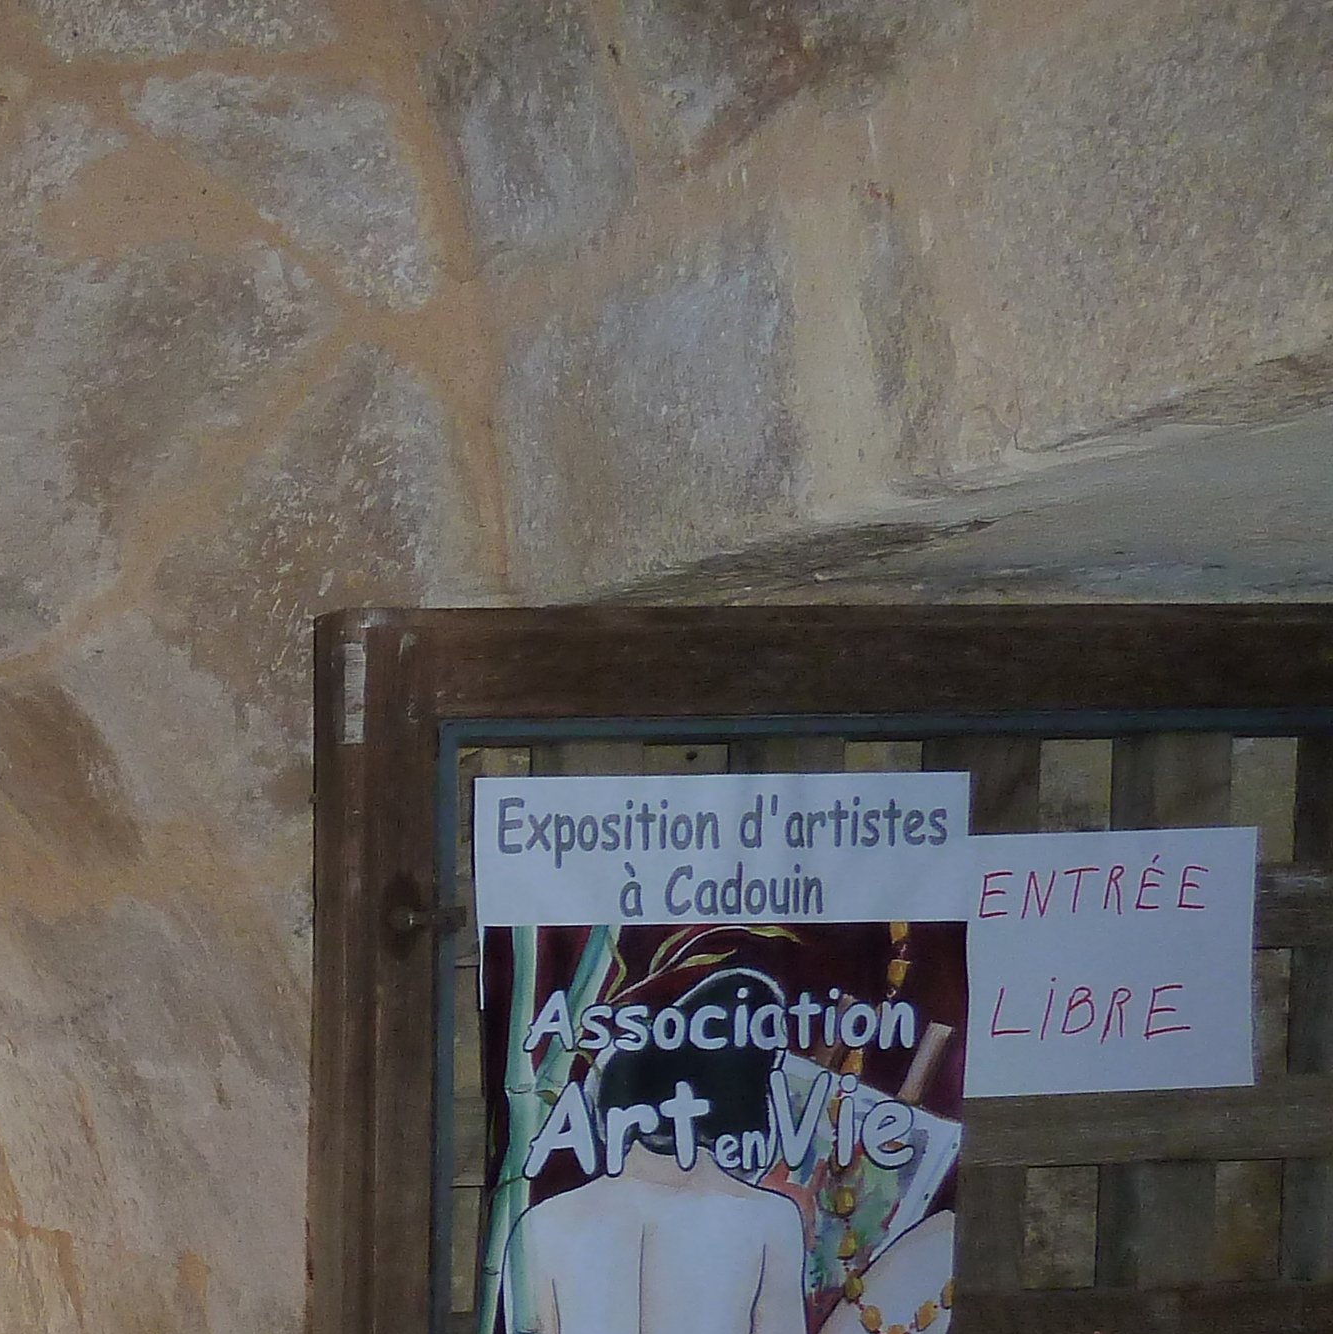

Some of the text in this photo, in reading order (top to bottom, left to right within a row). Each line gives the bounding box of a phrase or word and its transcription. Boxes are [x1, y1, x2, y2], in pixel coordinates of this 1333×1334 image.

[497, 794, 948, 868] Exposition d'artistes
[620, 862, 824, 917] à Cadouin
[979, 854, 1210, 919] ENTRÉE
[524, 988, 915, 1052] Association
[524, 1068, 914, 1178] Art en Vie
